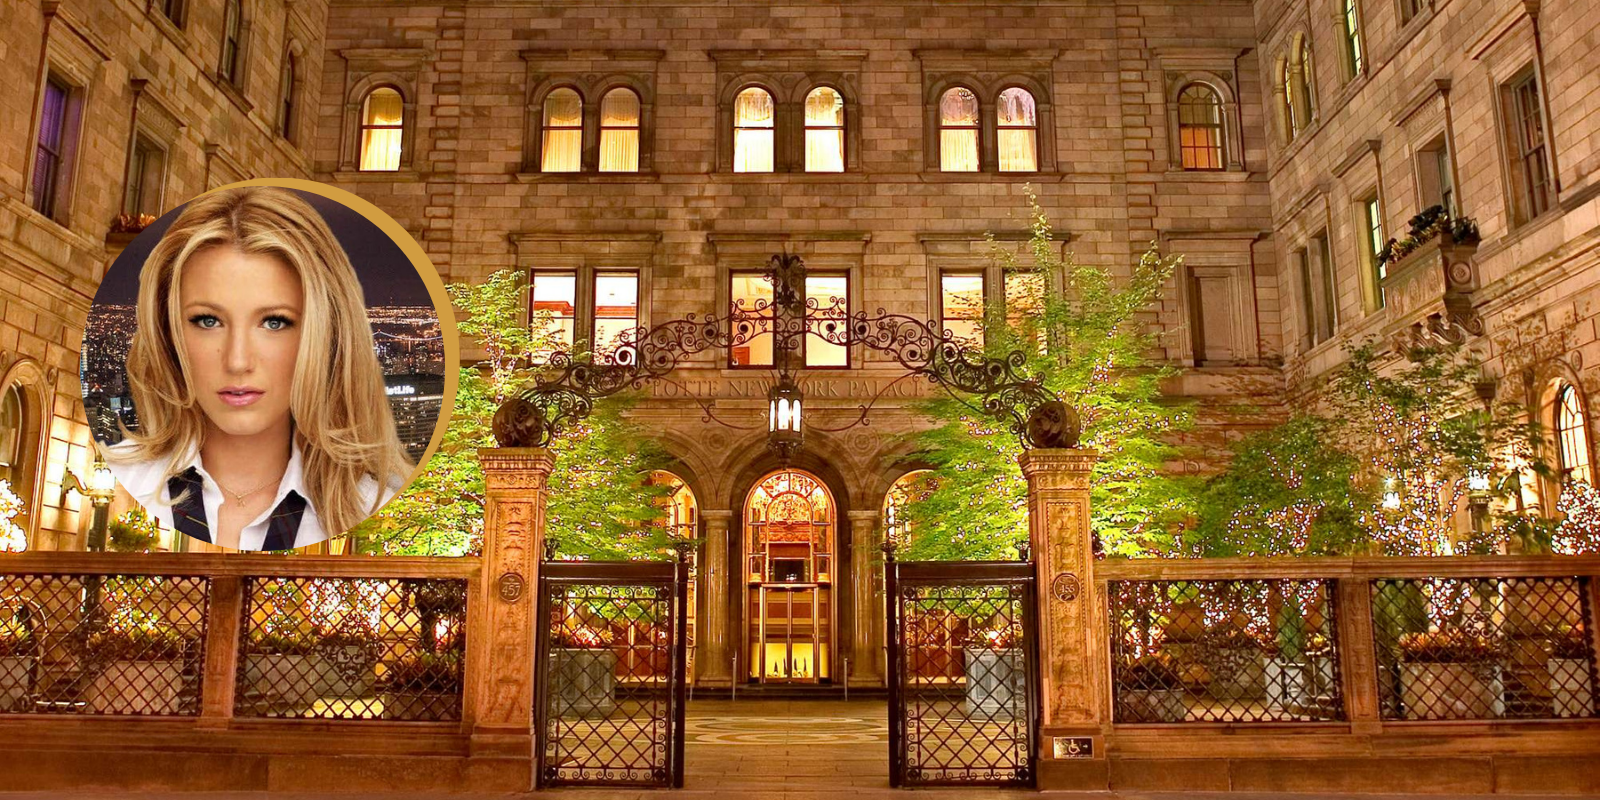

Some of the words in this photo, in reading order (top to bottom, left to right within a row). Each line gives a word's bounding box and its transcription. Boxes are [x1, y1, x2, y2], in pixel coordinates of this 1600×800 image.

[797, 380, 840, 397] ORK
[848, 380, 925, 397] PALACE
[501, 584, 521, 596] 457
[1059, 584, 1075, 593] 455
